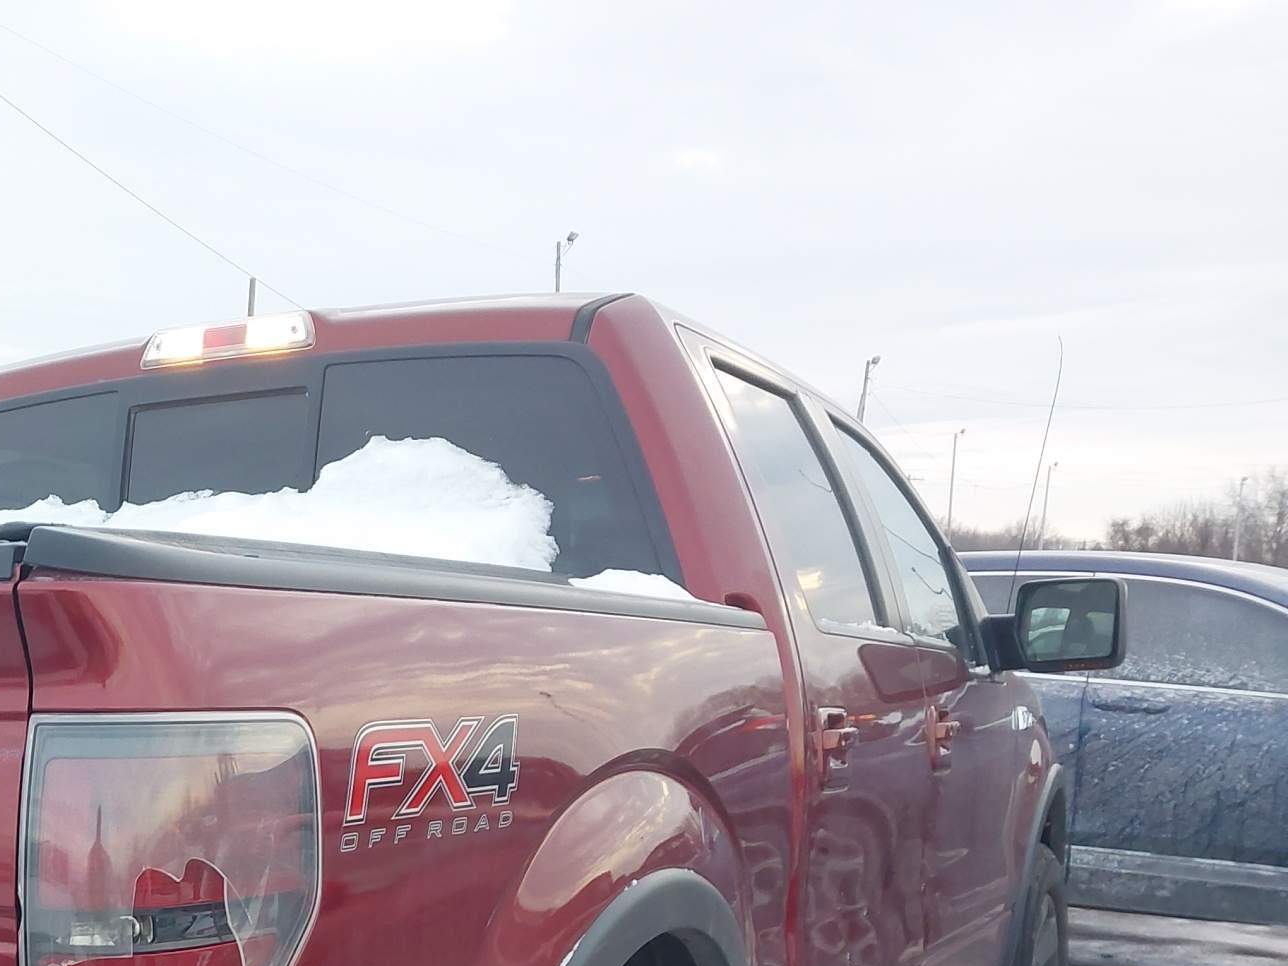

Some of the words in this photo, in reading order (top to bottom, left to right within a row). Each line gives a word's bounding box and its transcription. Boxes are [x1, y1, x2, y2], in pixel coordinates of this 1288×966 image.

[342, 713, 520, 827] FX4
[339, 824, 412, 853] OFF
[426, 810, 514, 840] ROAD
